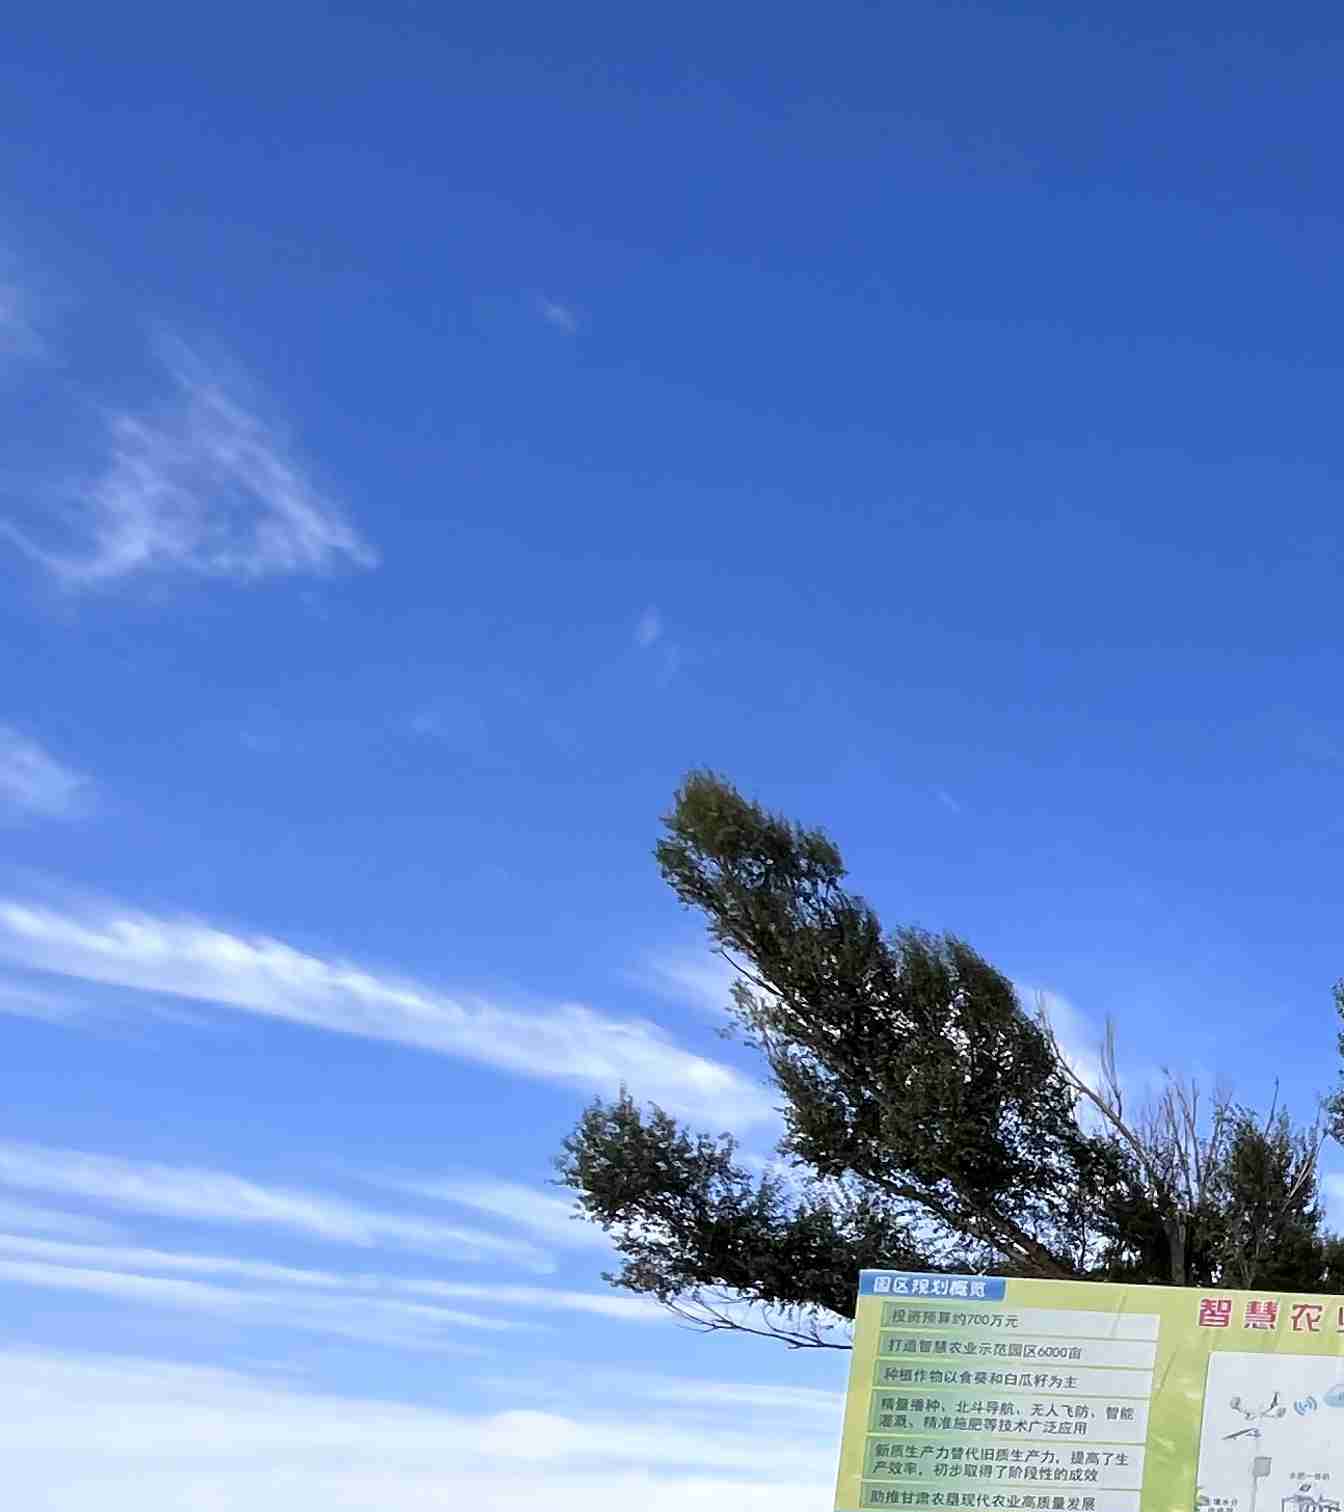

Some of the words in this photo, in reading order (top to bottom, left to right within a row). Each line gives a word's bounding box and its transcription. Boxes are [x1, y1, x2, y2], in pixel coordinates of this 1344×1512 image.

[873, 1276, 987, 1298] 园区规划概览
